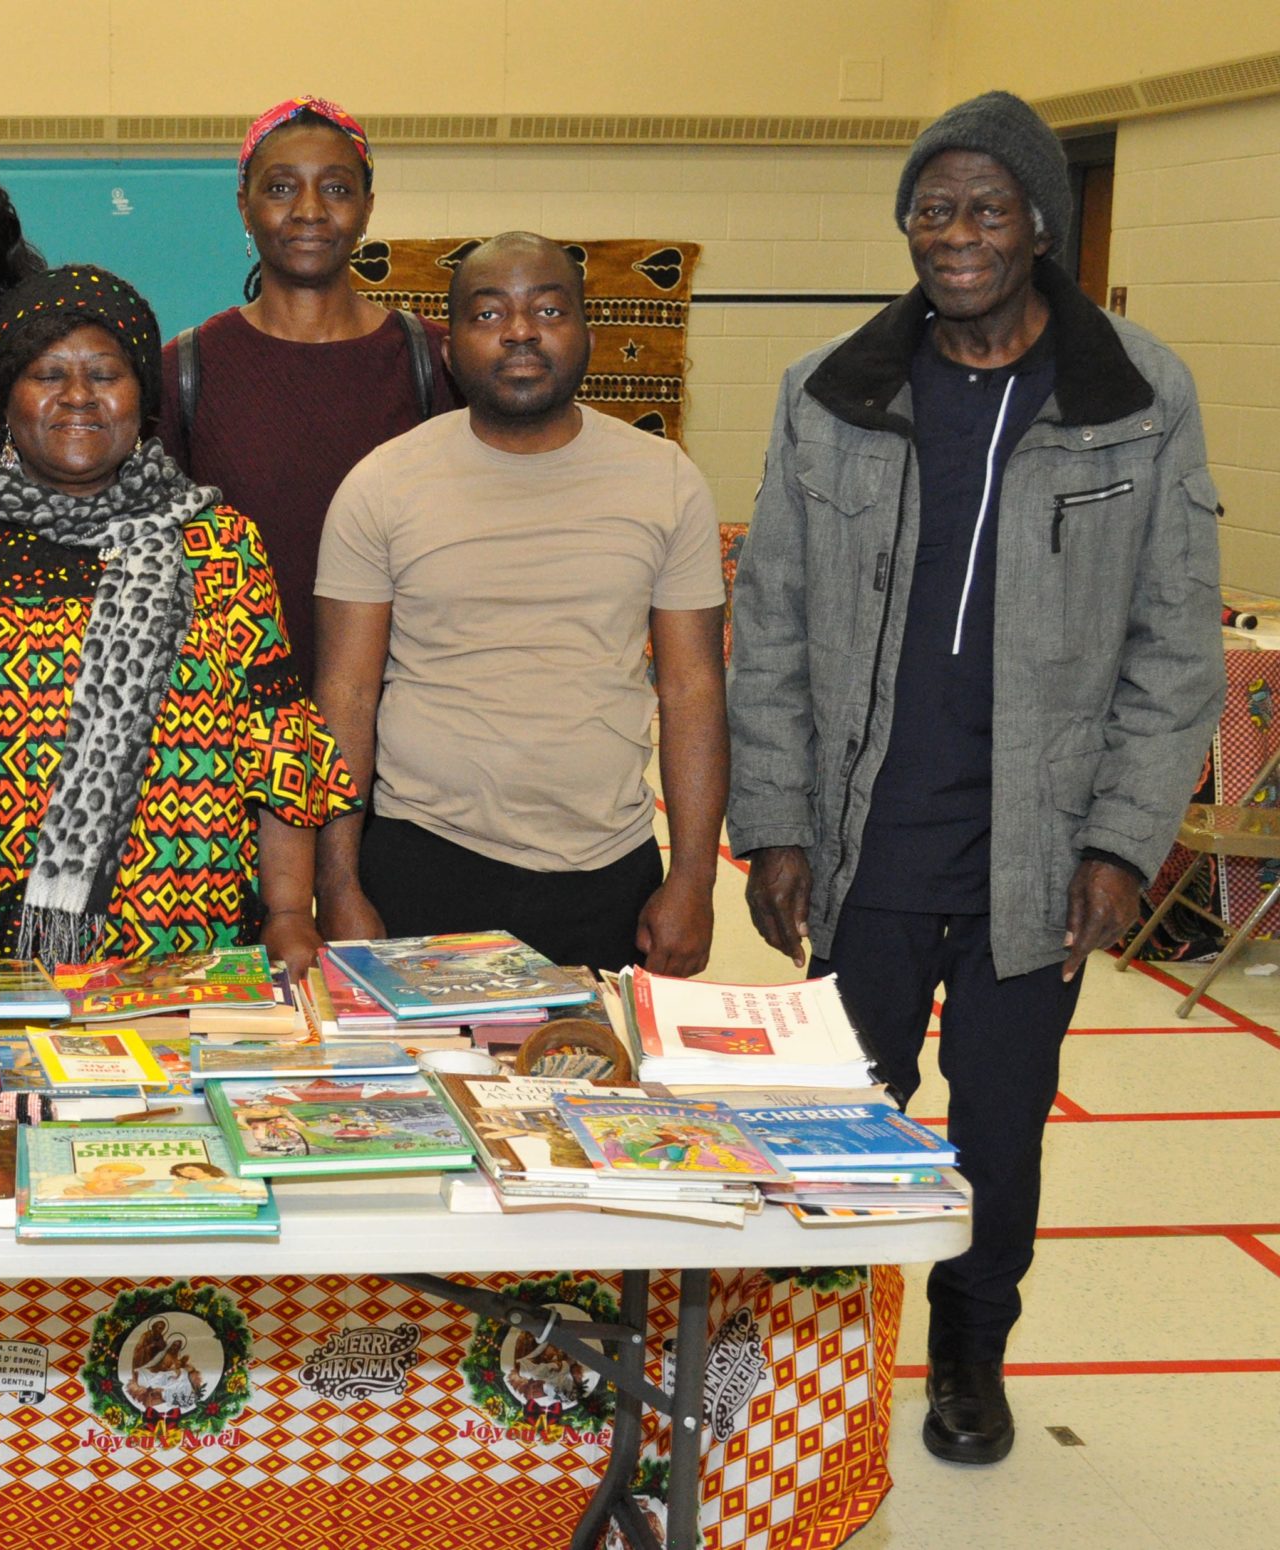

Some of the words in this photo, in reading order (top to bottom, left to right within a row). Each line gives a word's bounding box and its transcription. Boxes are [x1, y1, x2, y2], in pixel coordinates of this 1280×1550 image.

[720, 991, 740, 1020] d'enfants
[745, 999, 758, 1007] du
[786, 991, 809, 1025] Programme
[746, 1008, 764, 1025] jardin
[770, 1008, 795, 1039] maternelle
[479, 1083, 507, 1092] LA
[485, 1092, 551, 1103] ANTIQ
[567, 1104, 733, 1123] CENDRILLON
[738, 1106, 873, 1123] SCHERELLE
[76, 1149, 205, 1158] DENTISTE
[85, 1142, 152, 1151] CHEZ
[163, 1142, 193, 1150] LE
[325, 1331, 396, 1355] MERRY
[9, 1367, 45, 1378] PATIENTS
[298, 1354, 406, 1386] CHRISTMAS
[1, 1378, 35, 1388] GENTILS
[458, 1418, 552, 1444] Joyeux
[81, 1428, 170, 1453] Joyeux
[178, 1427, 243, 1449] Noël
